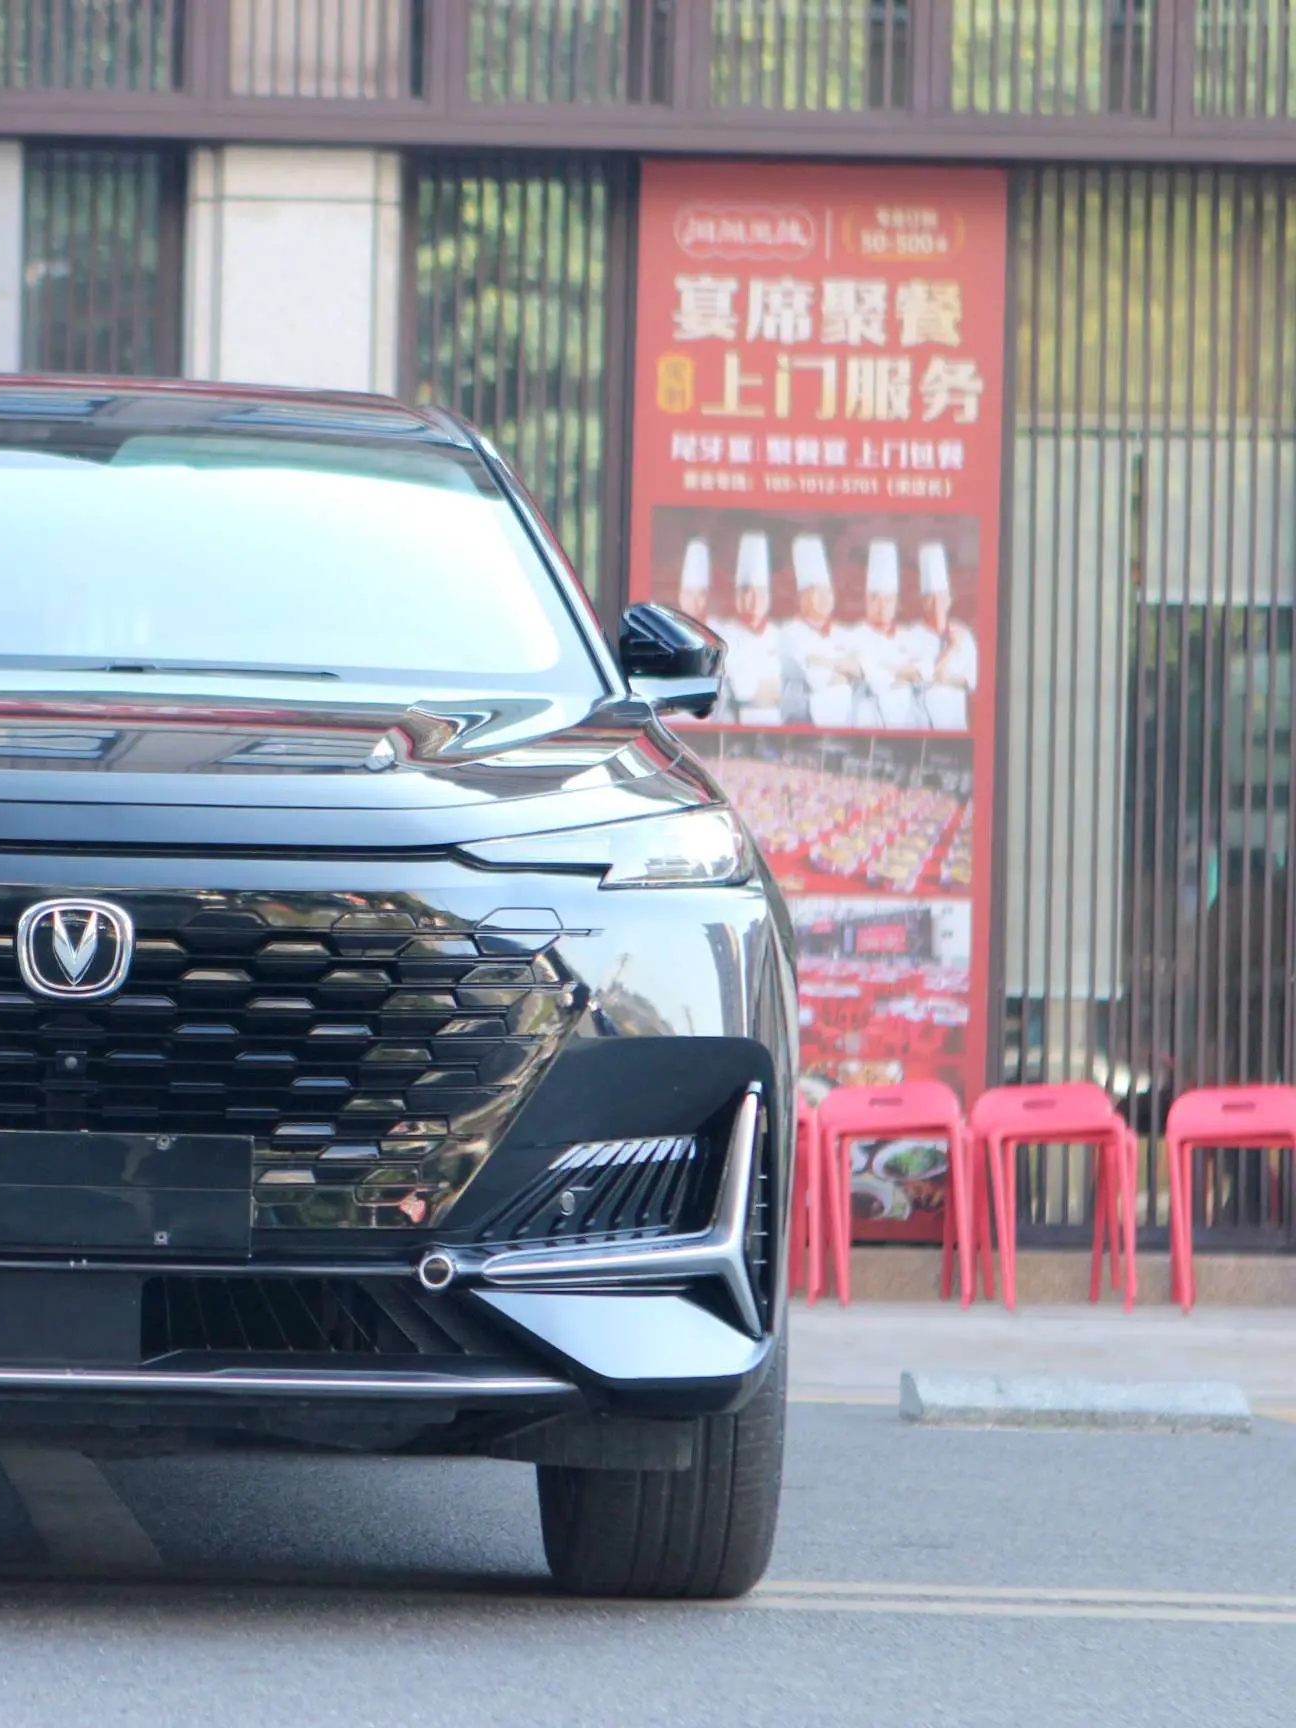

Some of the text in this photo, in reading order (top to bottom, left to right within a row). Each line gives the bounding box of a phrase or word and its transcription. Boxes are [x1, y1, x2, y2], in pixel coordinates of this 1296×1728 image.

[672, 274, 962, 347] 宴席聚餐
[700, 350, 984, 424] 上门服务
